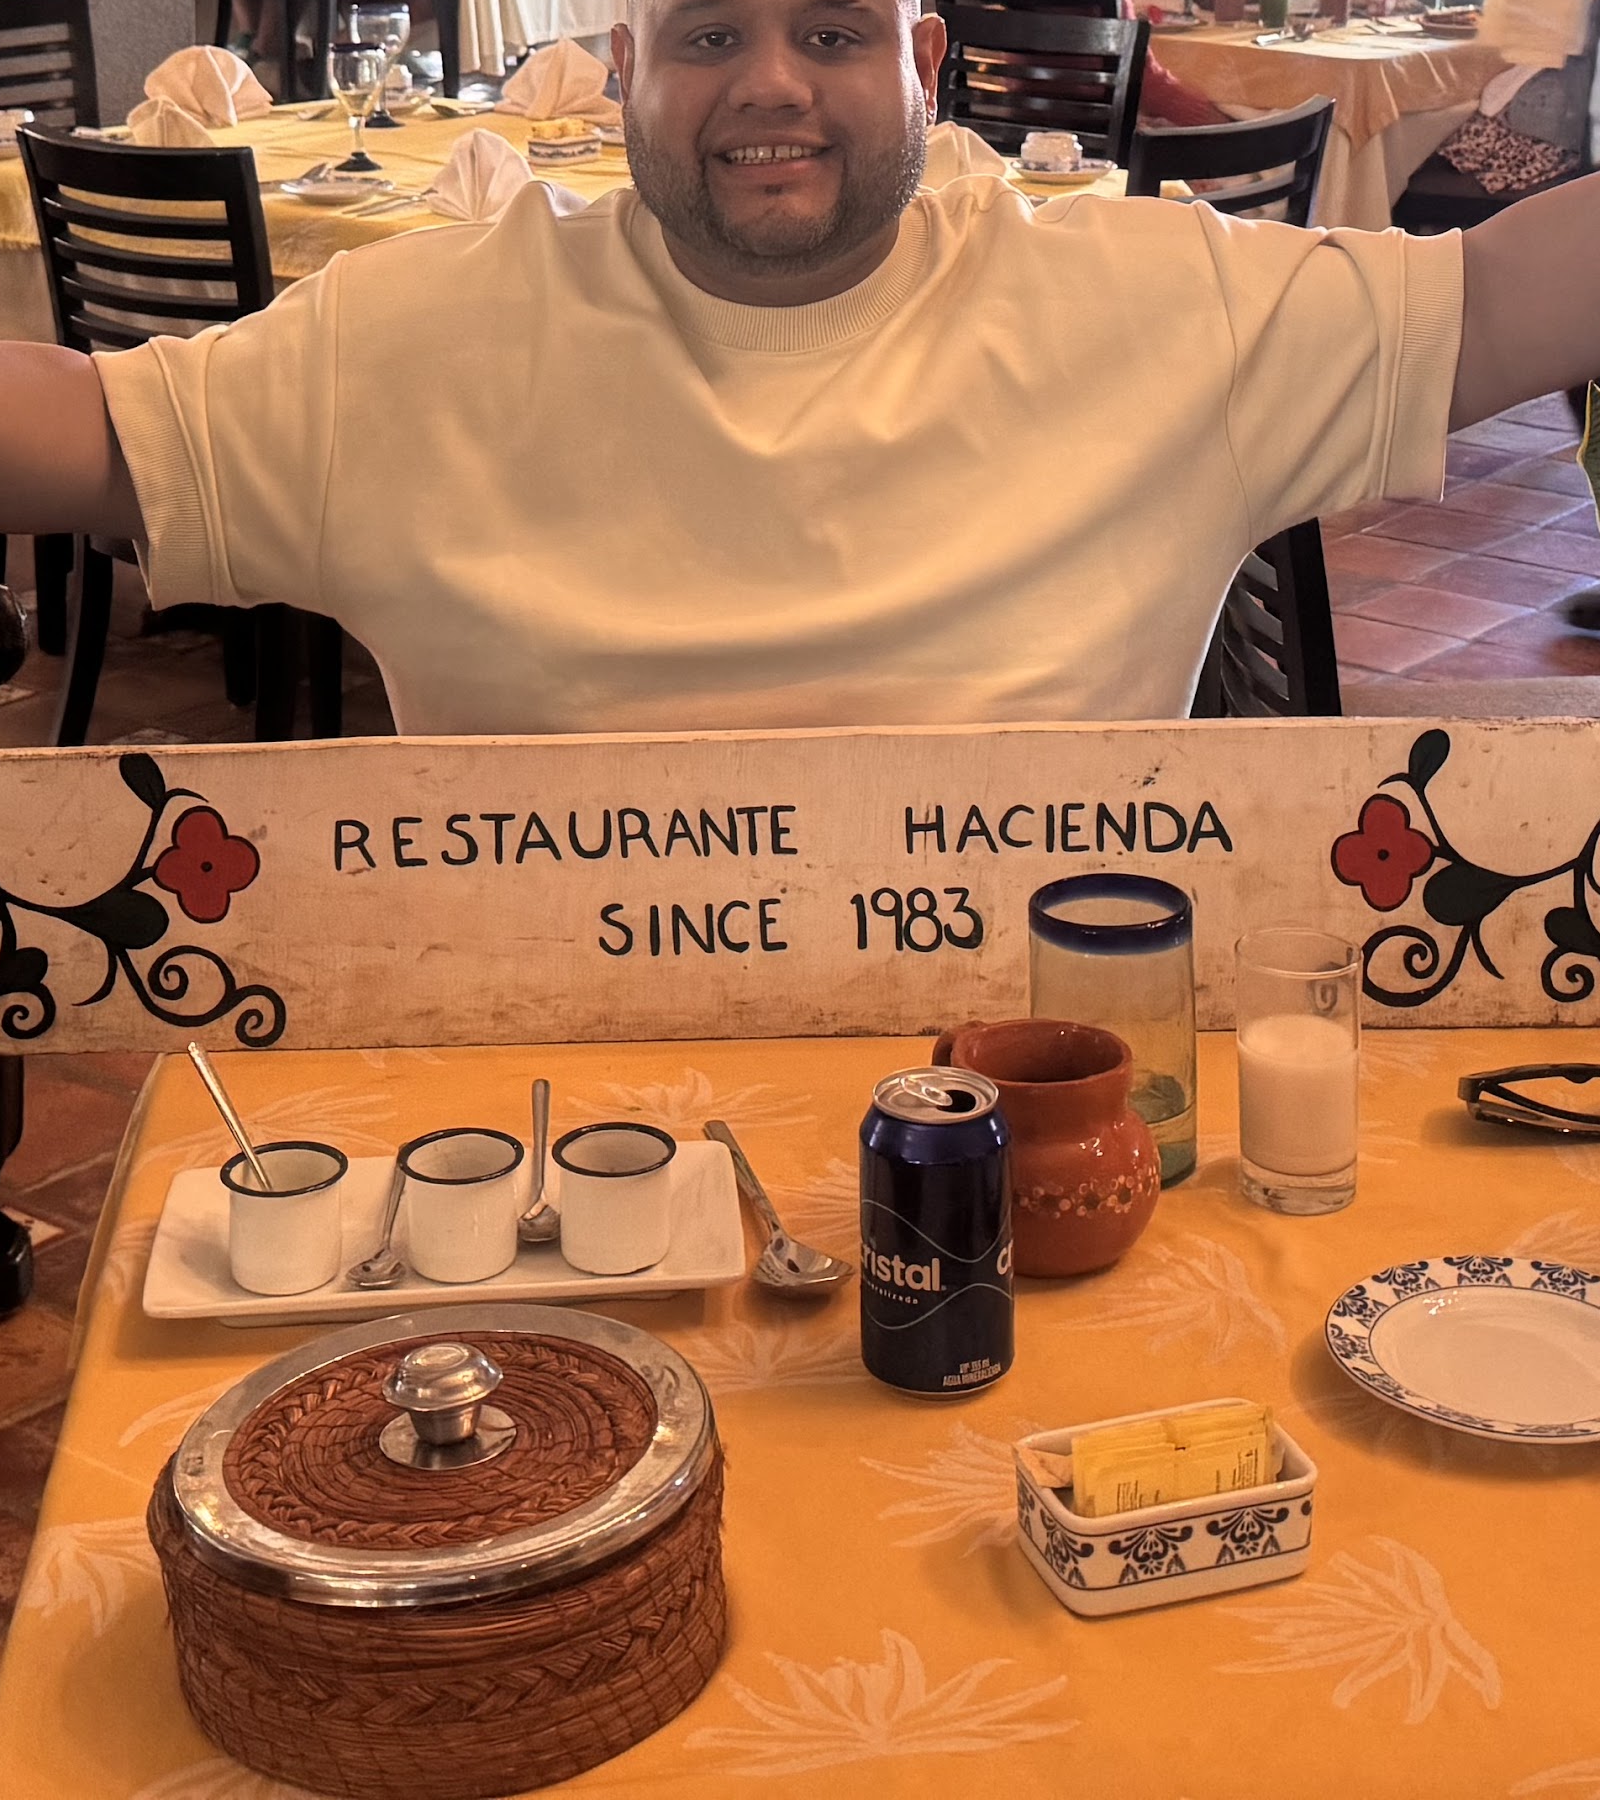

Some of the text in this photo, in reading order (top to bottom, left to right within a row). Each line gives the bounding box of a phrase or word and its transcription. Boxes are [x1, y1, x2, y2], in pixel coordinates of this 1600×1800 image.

[333, 800, 1234, 872] RESTAURANTE HACIENDA
[598, 886, 985, 958] SINCE 1983
[861, 1243, 942, 1292] ristal
